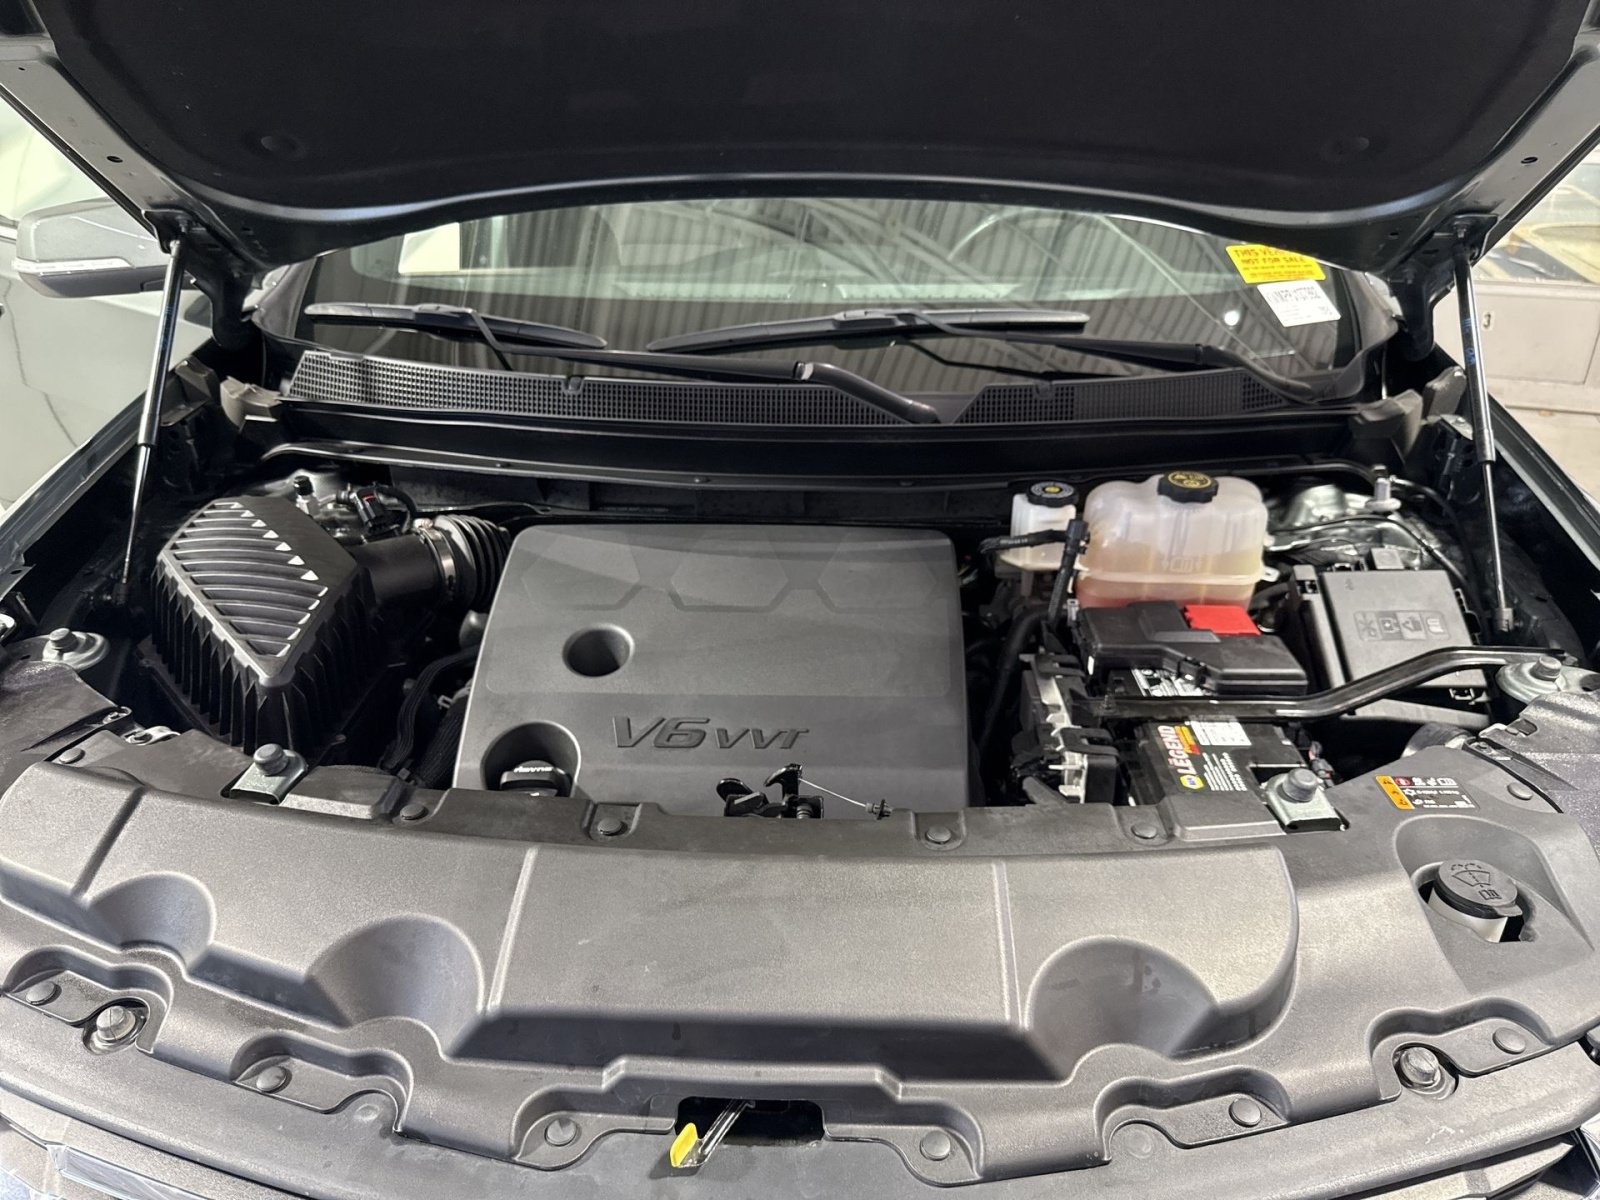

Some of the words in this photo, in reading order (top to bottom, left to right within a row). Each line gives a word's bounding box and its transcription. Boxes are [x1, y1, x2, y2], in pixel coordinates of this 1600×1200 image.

[1235, 249, 1259, 258] THIS
[613, 716, 710, 748] V6
[715, 728, 810, 749] VVT
